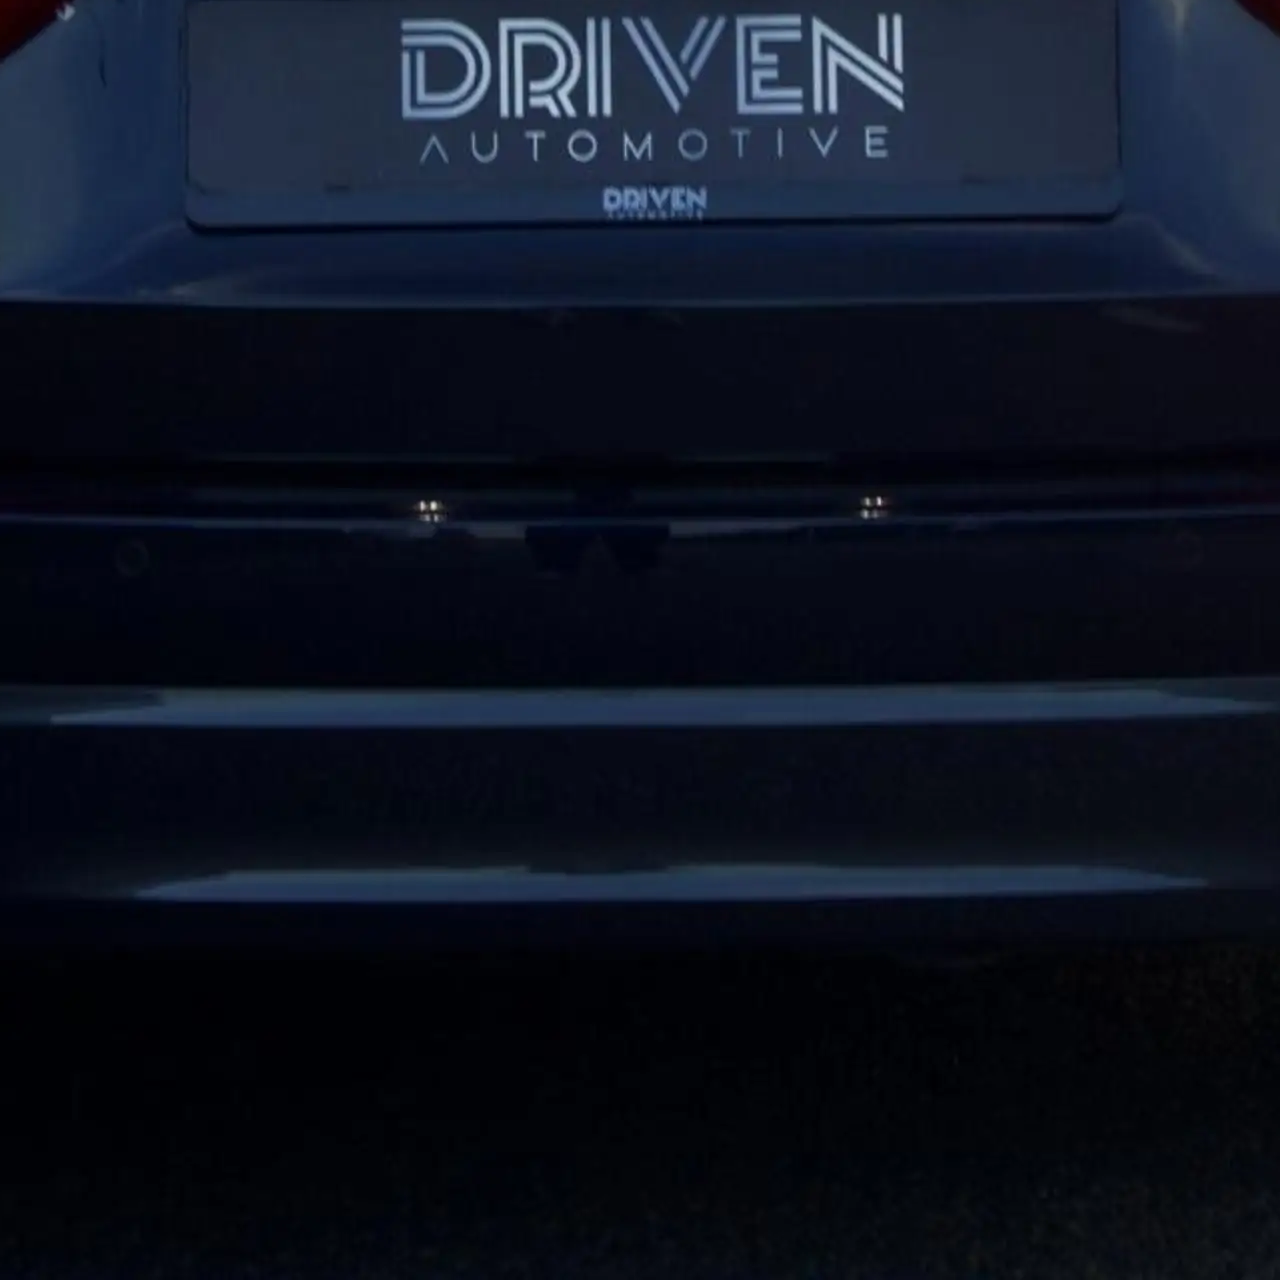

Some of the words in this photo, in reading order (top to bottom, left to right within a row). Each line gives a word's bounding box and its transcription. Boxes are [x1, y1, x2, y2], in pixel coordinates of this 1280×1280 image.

[401, 13, 904, 119] DRIVEN
[420, 126, 889, 164] AUTOMOTIVE
[603, 185, 708, 212] DRIVEN
